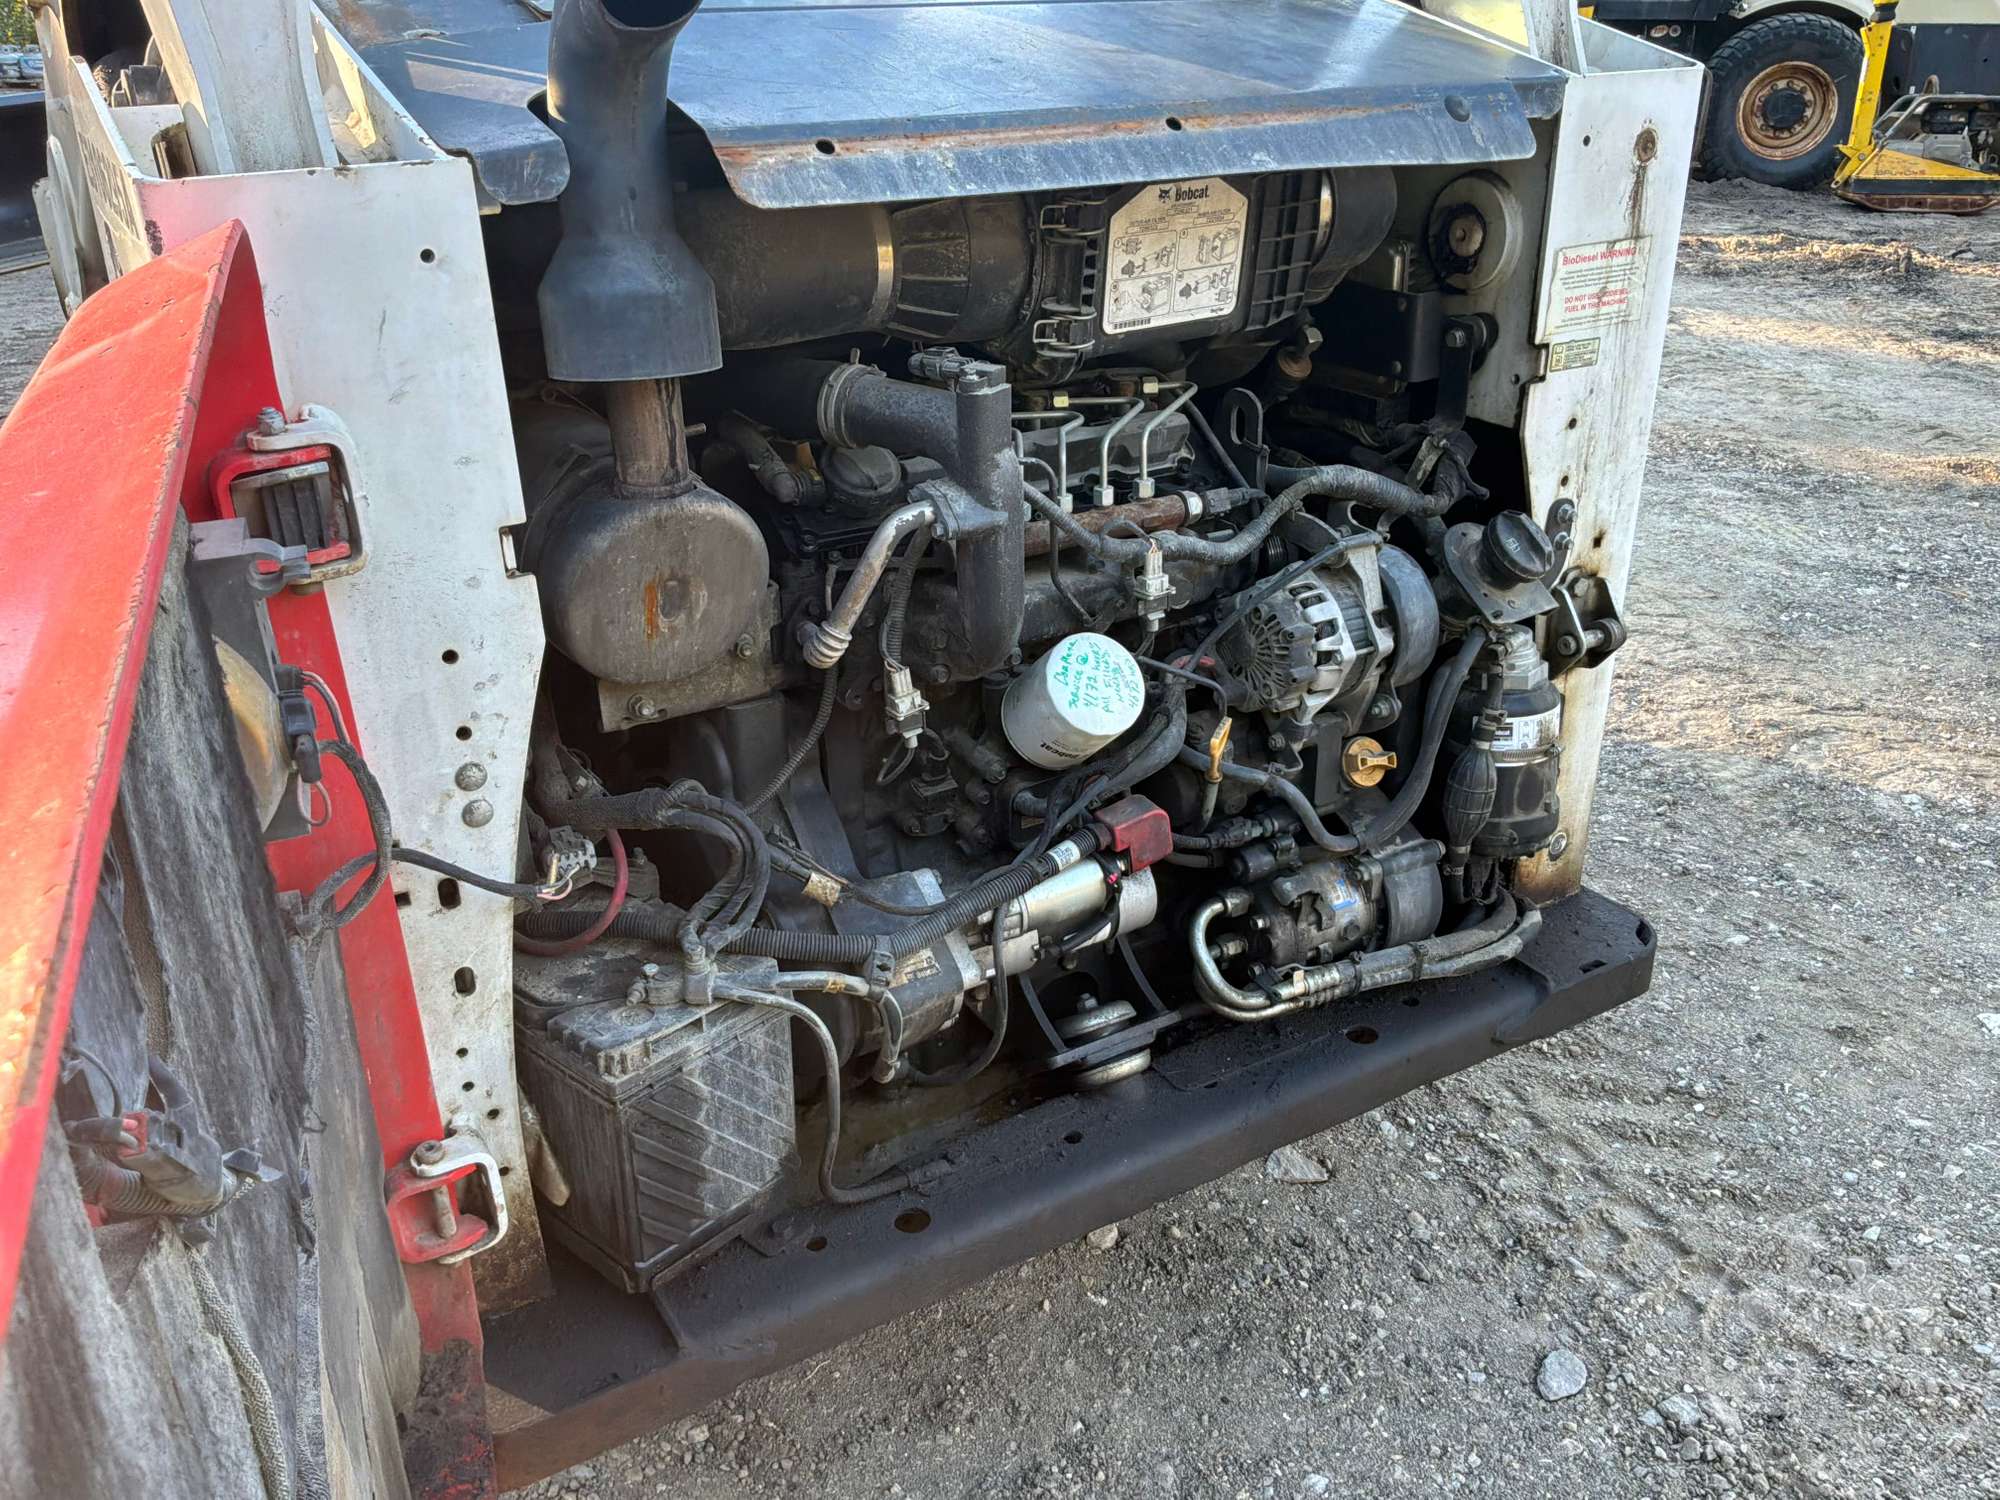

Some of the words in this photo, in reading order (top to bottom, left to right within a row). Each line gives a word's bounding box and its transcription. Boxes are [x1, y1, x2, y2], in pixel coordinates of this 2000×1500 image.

[1175, 184, 1209, 201] Bobcat
[1562, 252, 1599, 266] BioDiesel
[1600, 246, 1637, 260] WARNING
